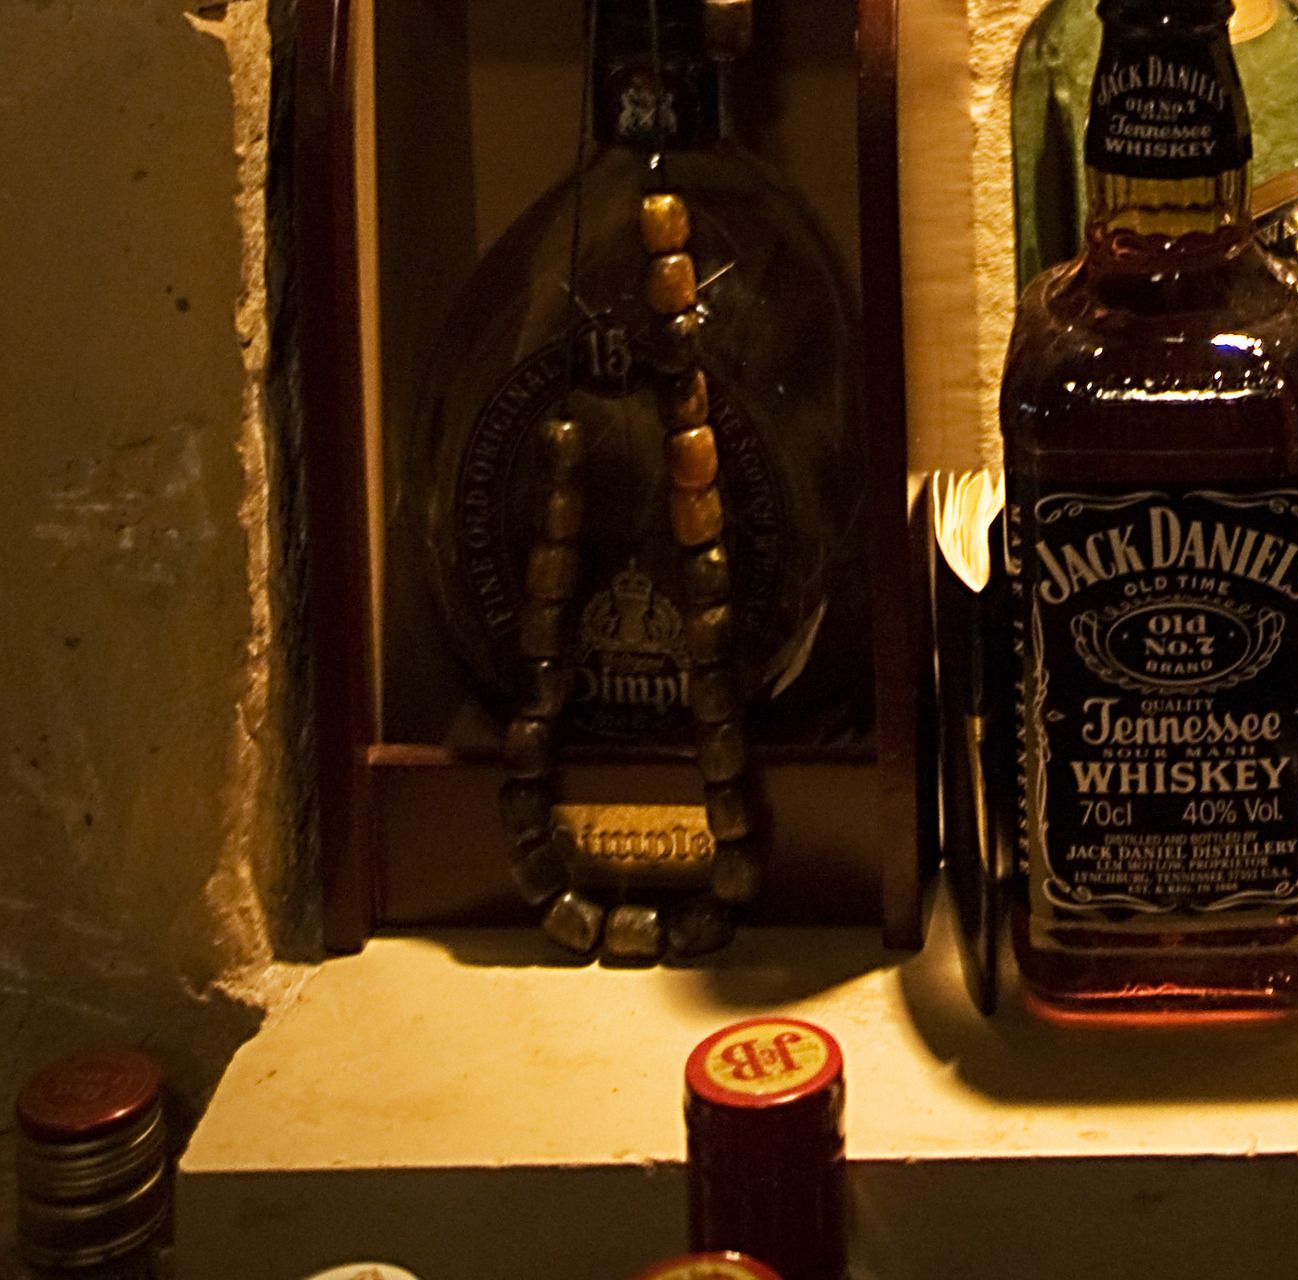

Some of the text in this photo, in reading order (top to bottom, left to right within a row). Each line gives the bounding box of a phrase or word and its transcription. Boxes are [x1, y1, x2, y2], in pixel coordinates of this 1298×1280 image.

[1096, 61, 1143, 107] JACK
[1109, 114, 1213, 139] Tennessee
[1105, 137, 1217, 159] WHISKEY
[588, 329, 632, 378] 15
[465, 488, 491, 551] OLD
[1035, 523, 1148, 606] JACK
[1123, 574, 1233, 598] OLD TIME
[1147, 613, 1208, 636] Old
[1143, 635, 1217, 659] No.7
[1144, 658, 1215, 676] BRAND
[1140, 697, 1216, 715] QUALITY
[1081, 696, 1283, 747] Tennessee
[1101, 745, 1257, 760] SOUR MASH
[1069, 756, 1292, 795] WHISKEY
[1078, 795, 1285, 828] 70cl 40% Vol.
[1066, 839, 1298, 861] JACK DANIEL DISTILLERY
